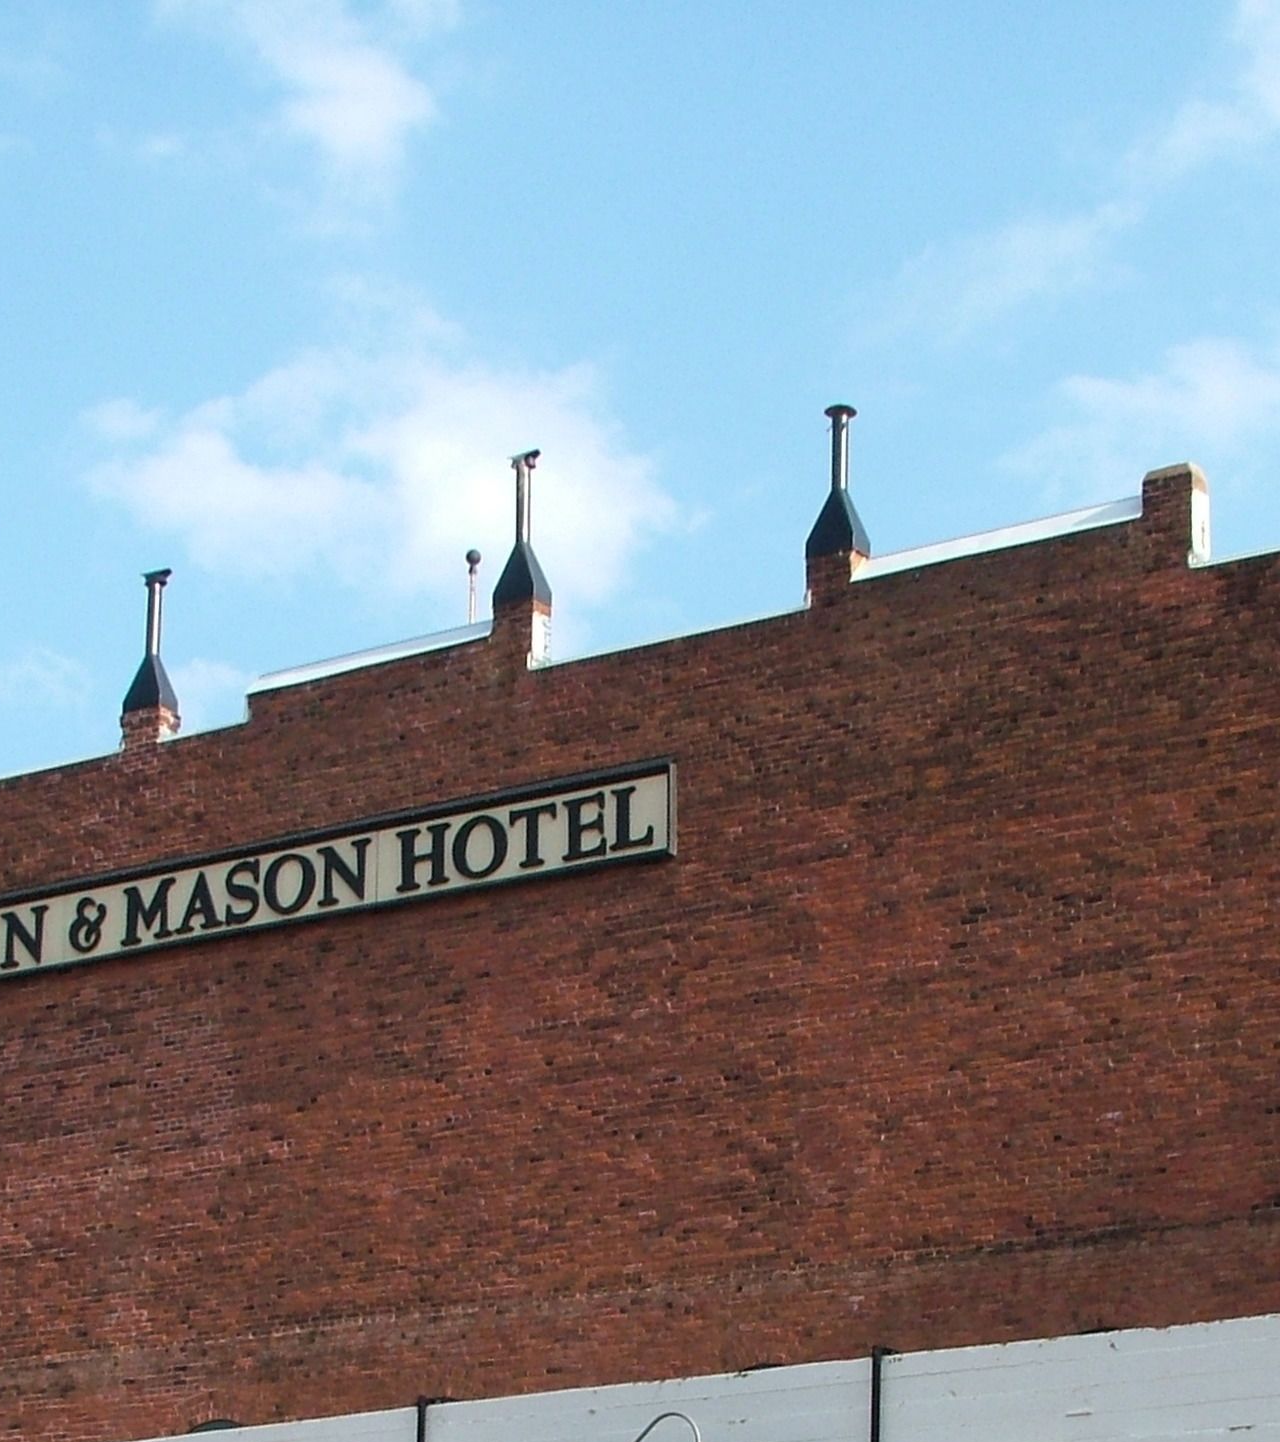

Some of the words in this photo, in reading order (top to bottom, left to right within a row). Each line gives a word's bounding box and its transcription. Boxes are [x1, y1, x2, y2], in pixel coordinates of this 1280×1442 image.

[69, 896, 108, 954] &
[120, 837, 373, 948] MASON
[396, 785, 655, 893] HOTEL
